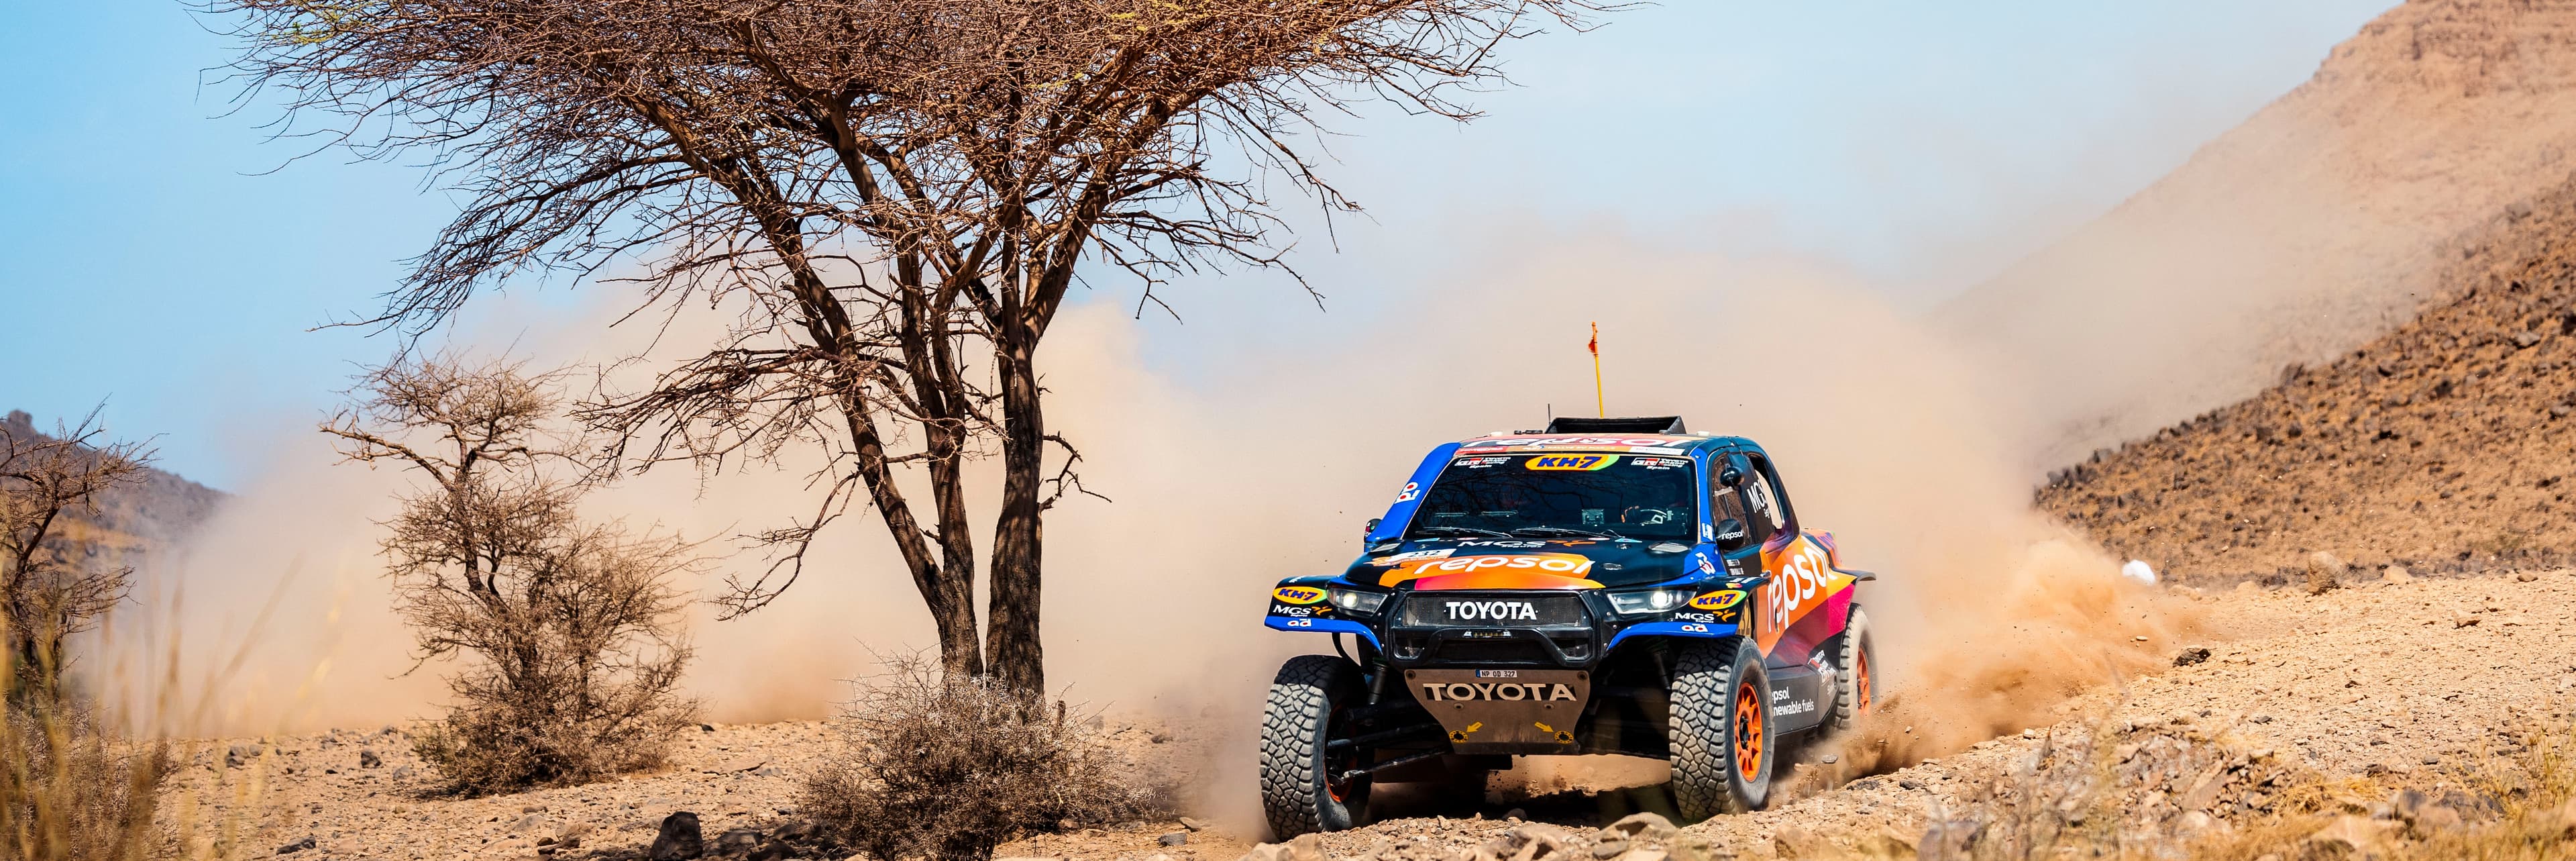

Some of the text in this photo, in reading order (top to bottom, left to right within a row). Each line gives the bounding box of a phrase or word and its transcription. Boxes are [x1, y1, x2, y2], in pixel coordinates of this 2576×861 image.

[1464, 438, 1692, 447] repsol
[1721, 530, 1743, 540] repsol
[1414, 556, 1596, 574] repsol
[1768, 536, 1838, 634] repsol
[1273, 605, 1311, 615] MGS
[1446, 601, 1537, 620] TOYOTA
[1675, 612, 1715, 621] MGS
[1423, 682, 1576, 701] TOYOTA
[1772, 686, 1790, 704] psol
[1773, 699, 1815, 716] newable fuels
